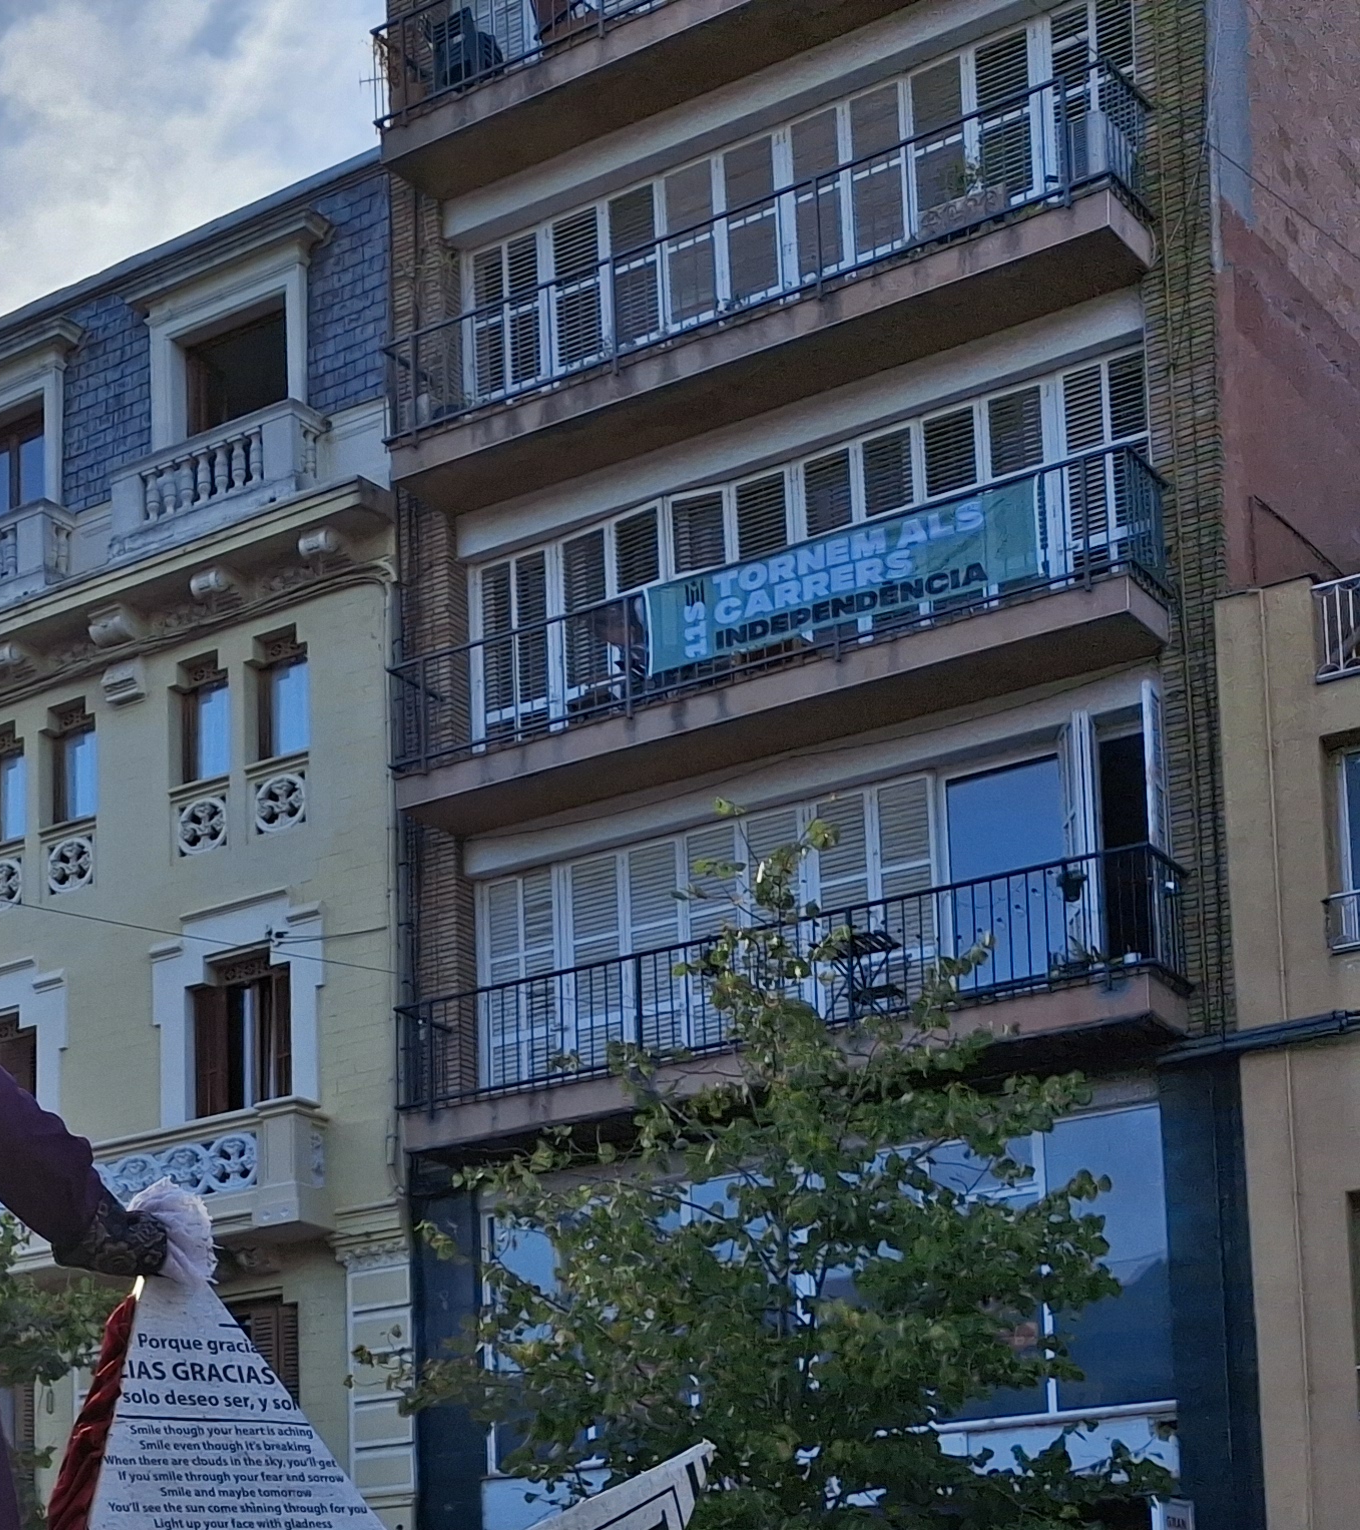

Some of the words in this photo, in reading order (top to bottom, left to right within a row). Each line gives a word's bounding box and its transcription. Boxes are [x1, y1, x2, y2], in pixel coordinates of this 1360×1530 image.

[712, 528, 887, 597] TORNEM
[896, 500, 985, 550] ALS
[714, 549, 913, 625] CARRERS
[716, 562, 988, 650] INDEPENDÈNCIA
[137, 1333, 202, 1352] Porque
[171, 1361, 278, 1385] GRACIAS
[122, 1387, 160, 1404] solo
[164, 1389, 219, 1406] deseo
[223, 1396, 254, 1410] ser,
[257, 1397, 267, 1412] y
[162, 1424, 204, 1438] though
[206, 1427, 231, 1438] your
[233, 1424, 265, 1435] heart
[266, 1425, 275, 1435] is
[277, 1426, 314, 1439] aching
[138, 1439, 170, 1450] Smile
[173, 1442, 201, 1450] even
[201, 1439, 243, 1453] though
[262, 1440, 311, 1454] breaking
[159, 1486, 191, 1497] Smile
[194, 1486, 215, 1497] and
[217, 1486, 255, 1499] maybe
[257, 1488, 311, 1497] tomorrow
[107, 1501, 139, 1512] You'll
[142, 1504, 160, 1512] see
[162, 1501, 182, 1513] the
[184, 1504, 205, 1512] sun
[207, 1505, 237, 1513] come
[239, 1501, 281, 1515] shining
[282, 1502, 328, 1515] through
[329, 1502, 344, 1513] for
[346, 1505, 369, 1516] you
[153, 1517, 184, 1530] Light
[185, 1520, 201, 1530] up
[202, 1520, 228, 1530] your
[230, 1517, 254, 1528] face
[255, 1518, 281, 1528] with
[283, 1517, 333, 1530] gladness
